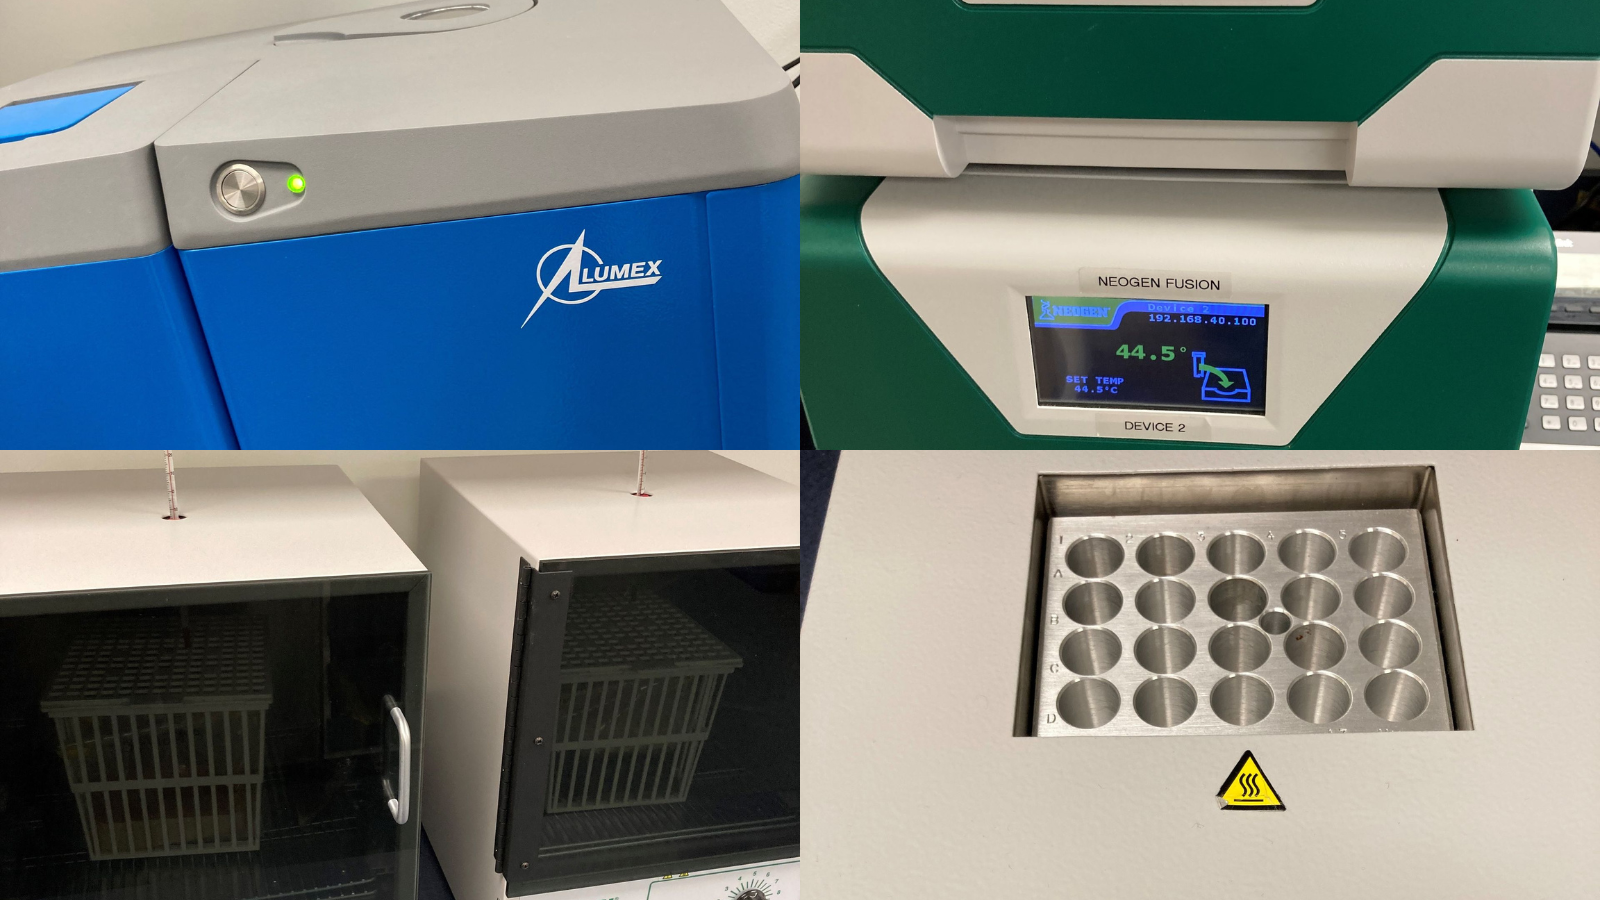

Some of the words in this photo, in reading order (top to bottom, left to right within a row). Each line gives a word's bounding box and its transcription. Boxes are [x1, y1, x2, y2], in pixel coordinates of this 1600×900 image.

[1098, 276, 1161, 289] NEOGEN
[1166, 278, 1221, 291] FUSION
[1052, 305, 1109, 318] NEOGEN
[1148, 303, 1195, 313] Device
[1202, 305, 1210, 314] 2
[1149, 313, 1257, 326] 192.168.40.100
[1115, 344, 1187, 361] 44.5°
[1066, 375, 1088, 384] SET
[1095, 376, 1124, 385] TEMP
[1074, 384, 1118, 394] 44.5°C
[1124, 420, 1174, 432] DEVICE
[1178, 423, 1186, 433] 2
[1050, 614, 1059, 626] B
[1049, 662, 1059, 674] C
[1046, 713, 1057, 724] D
